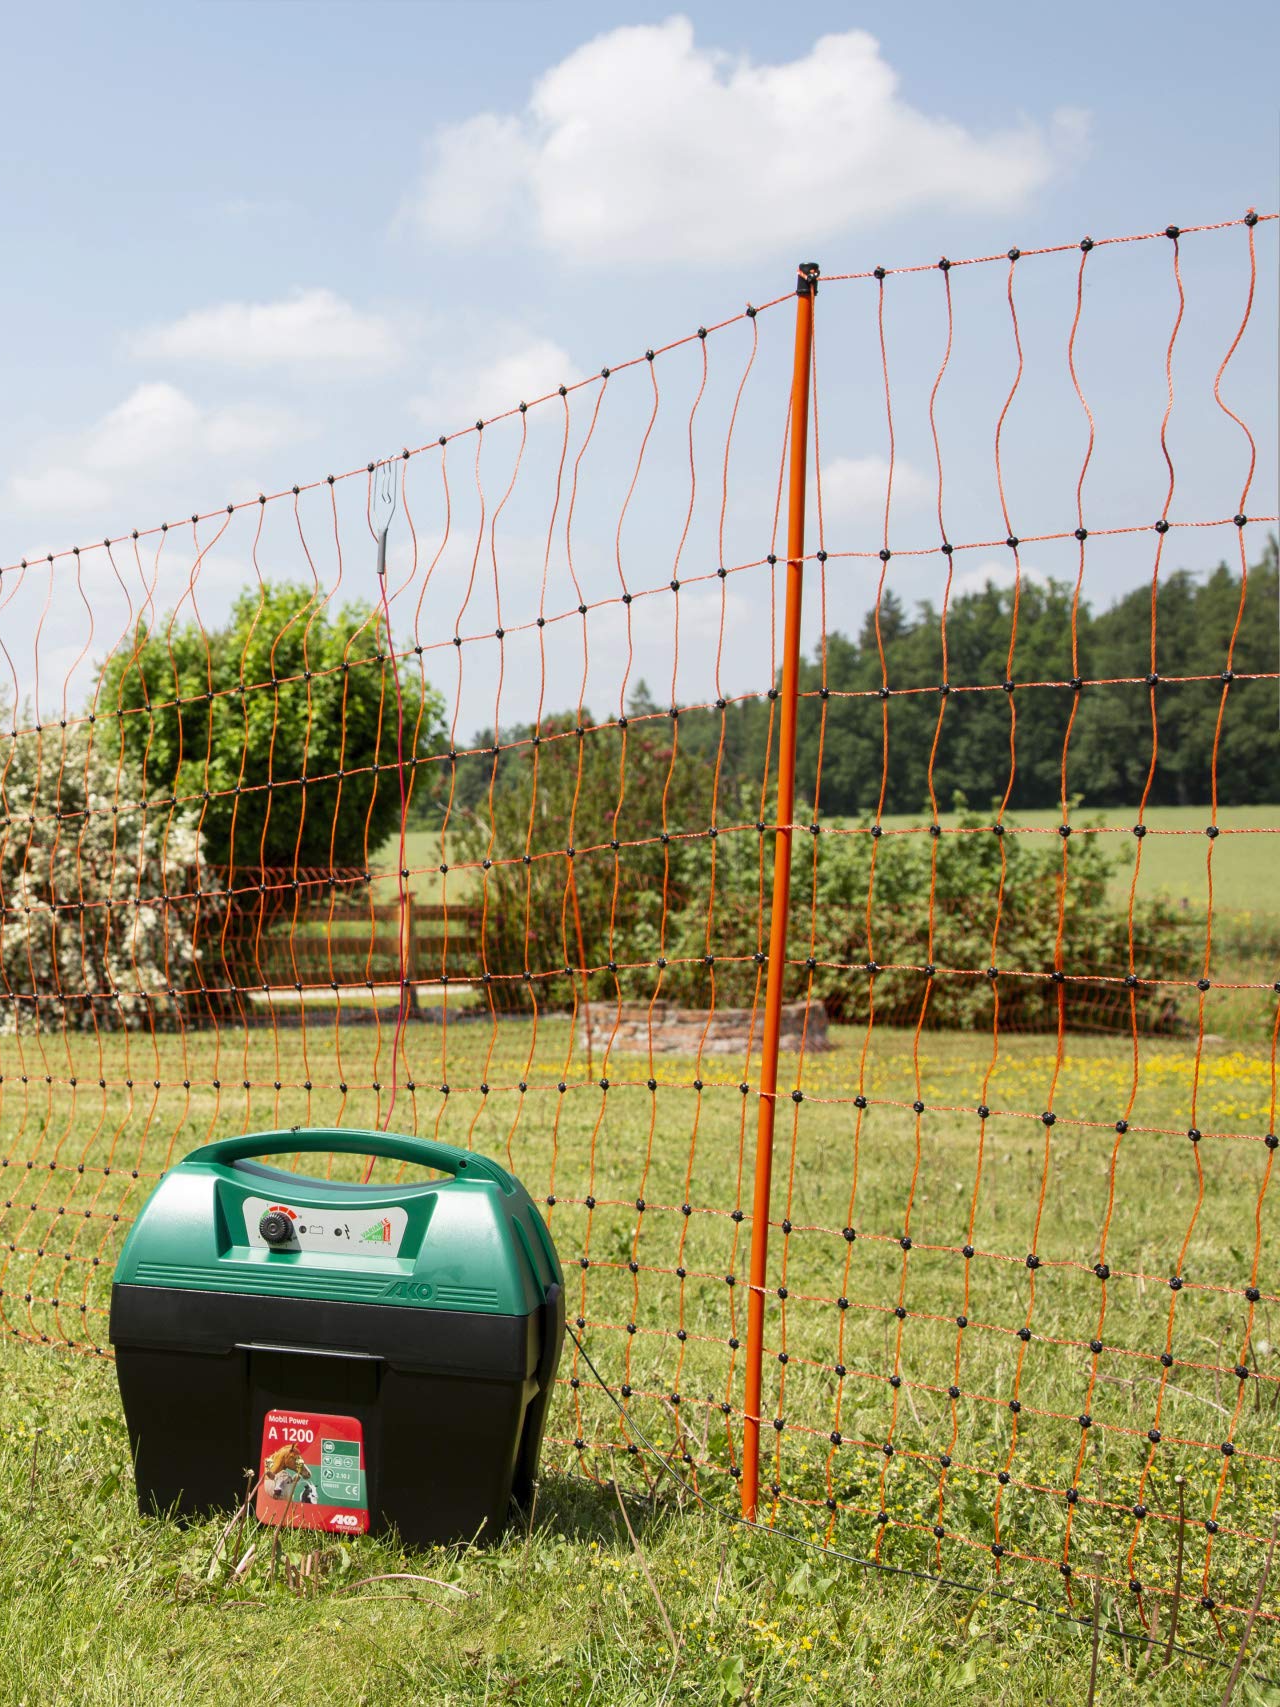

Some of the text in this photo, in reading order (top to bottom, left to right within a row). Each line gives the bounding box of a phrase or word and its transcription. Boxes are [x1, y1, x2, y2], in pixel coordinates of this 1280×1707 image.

[384, 1281, 433, 1301] AKO
[268, 1415, 309, 1425] Mobil Power
[268, 1426, 314, 1443] A 1200
[345, 1485, 358, 1496] CE
[330, 1514, 358, 1526] AKO
